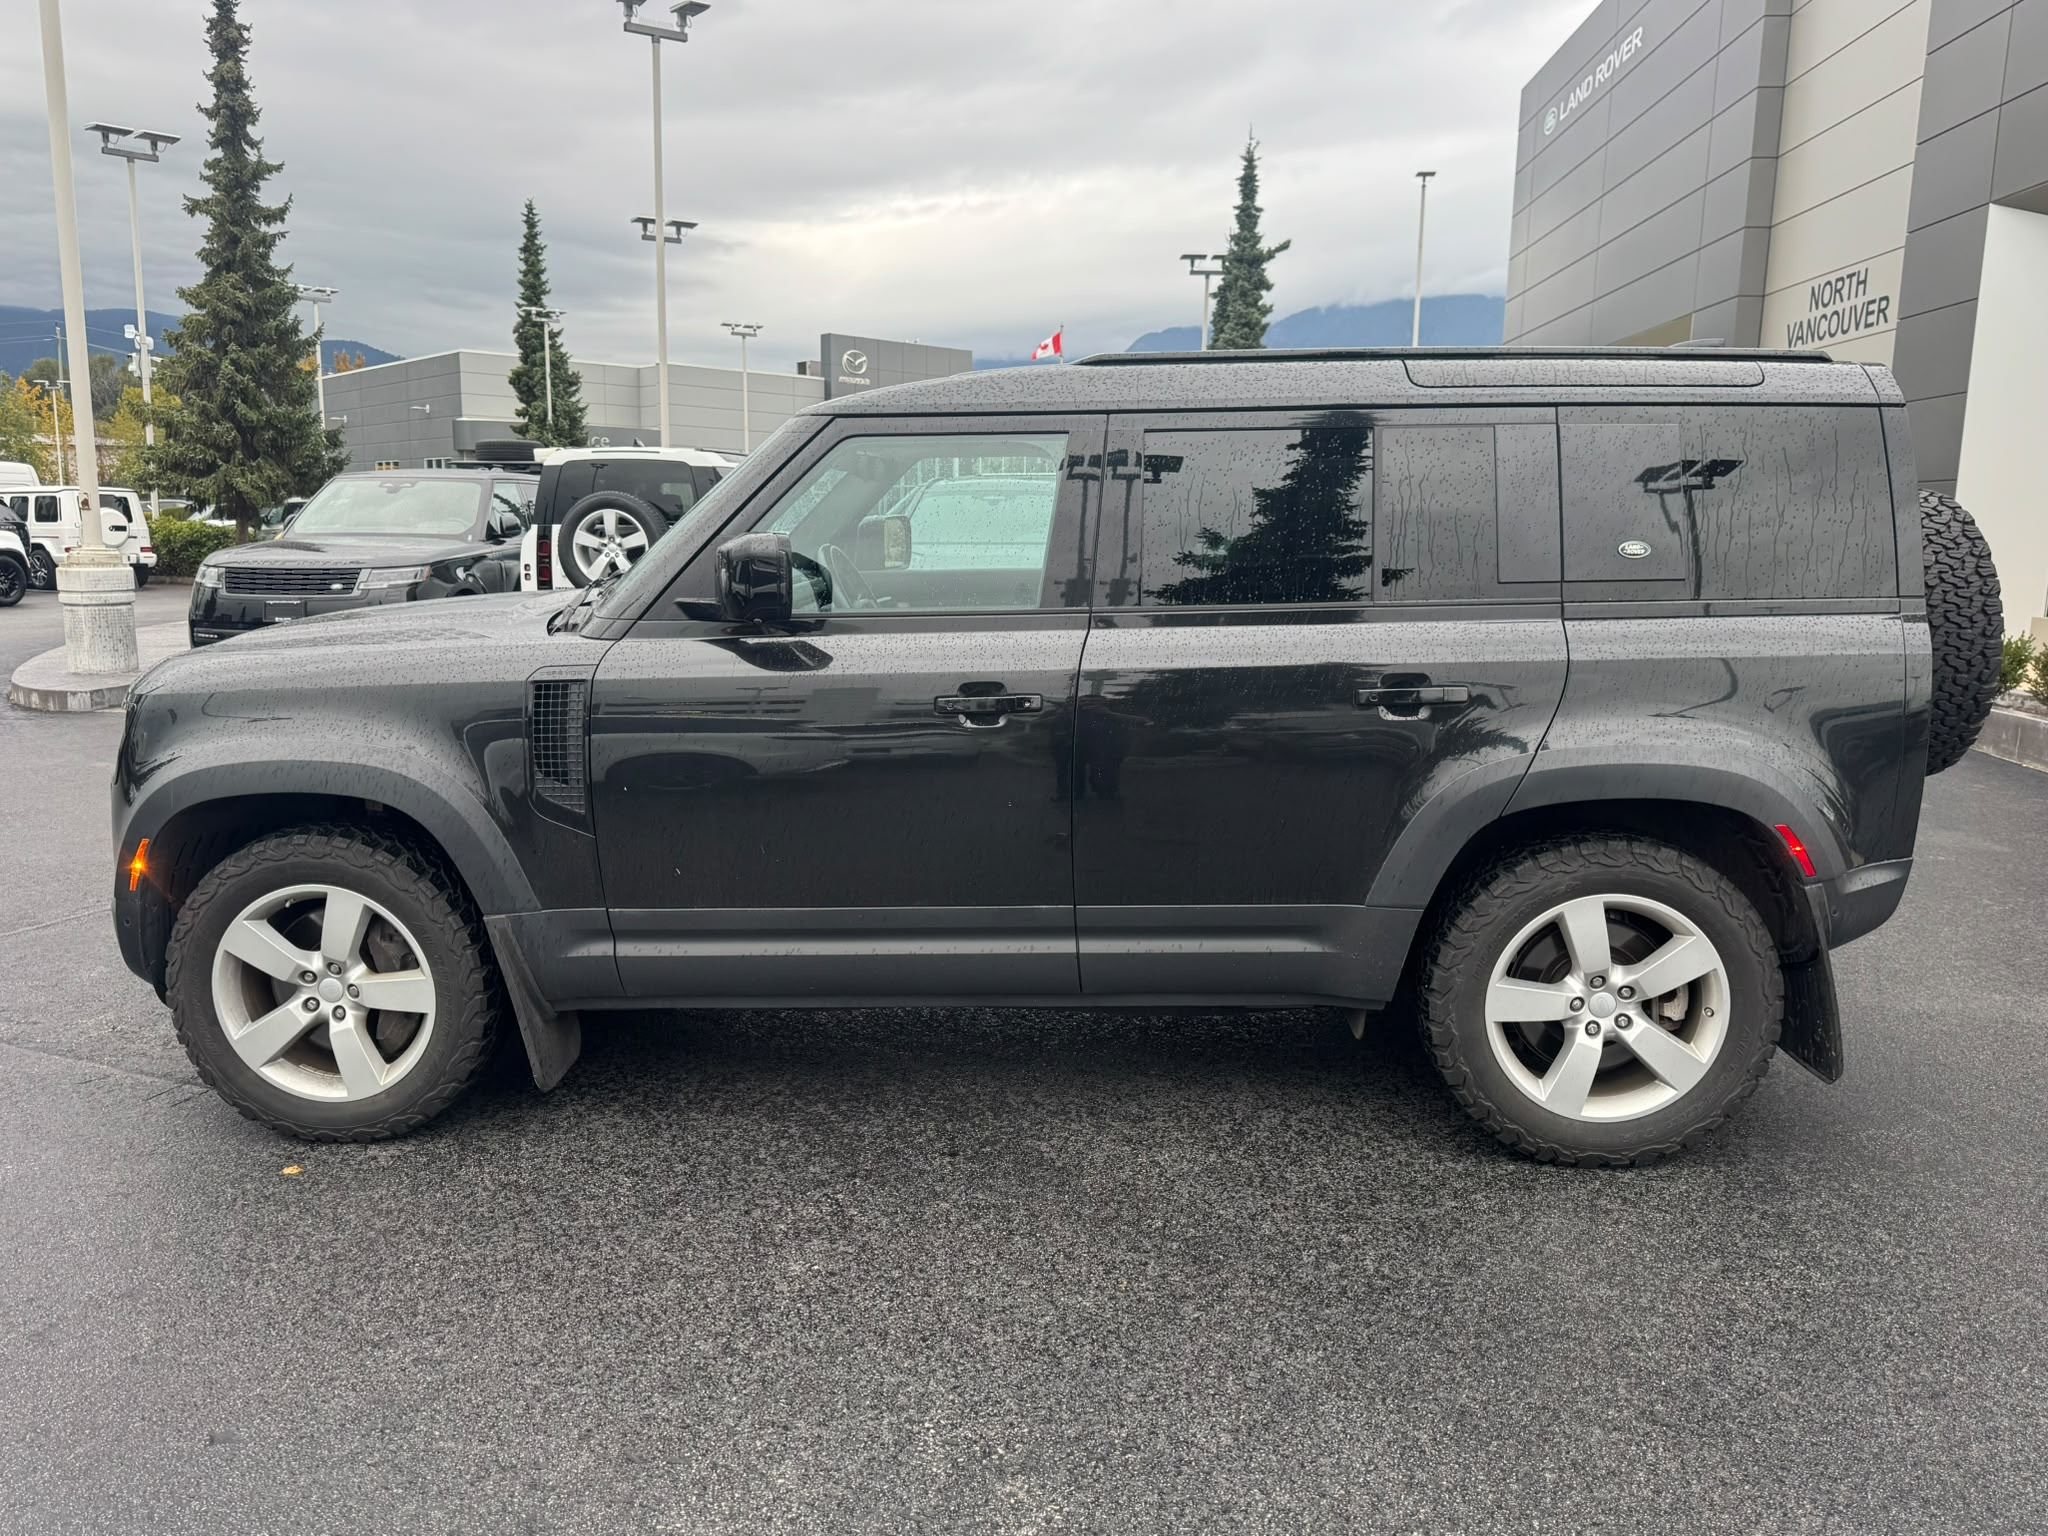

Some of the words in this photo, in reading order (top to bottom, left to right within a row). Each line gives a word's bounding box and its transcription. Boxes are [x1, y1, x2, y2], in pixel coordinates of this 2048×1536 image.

[1560, 74, 1593, 121] LAND
[1595, 26, 1643, 88] ROVER
[1809, 267, 1868, 313] NORTH
[1787, 295, 1890, 349] VANCOUVER
